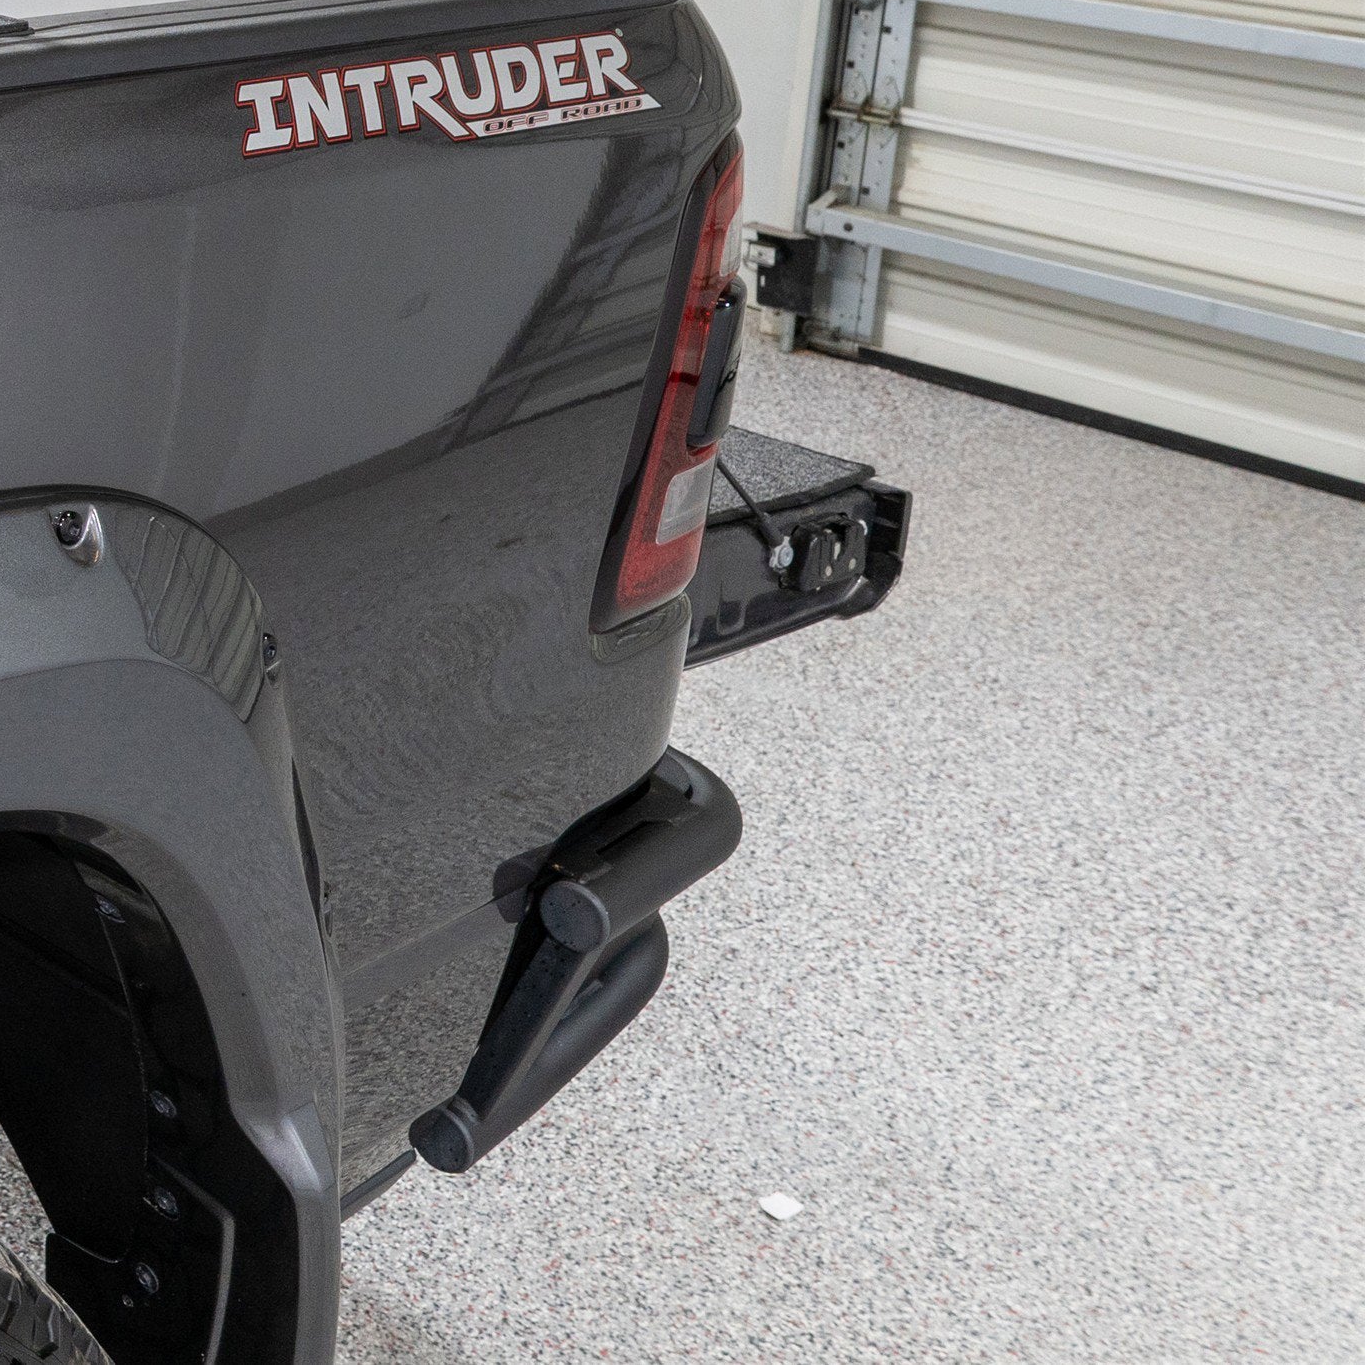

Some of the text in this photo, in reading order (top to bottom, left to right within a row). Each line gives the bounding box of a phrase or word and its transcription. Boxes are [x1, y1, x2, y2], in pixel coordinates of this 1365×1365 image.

[236, 31, 642, 155] INTRUDER
[484, 97, 643, 133] OFF ROAD
